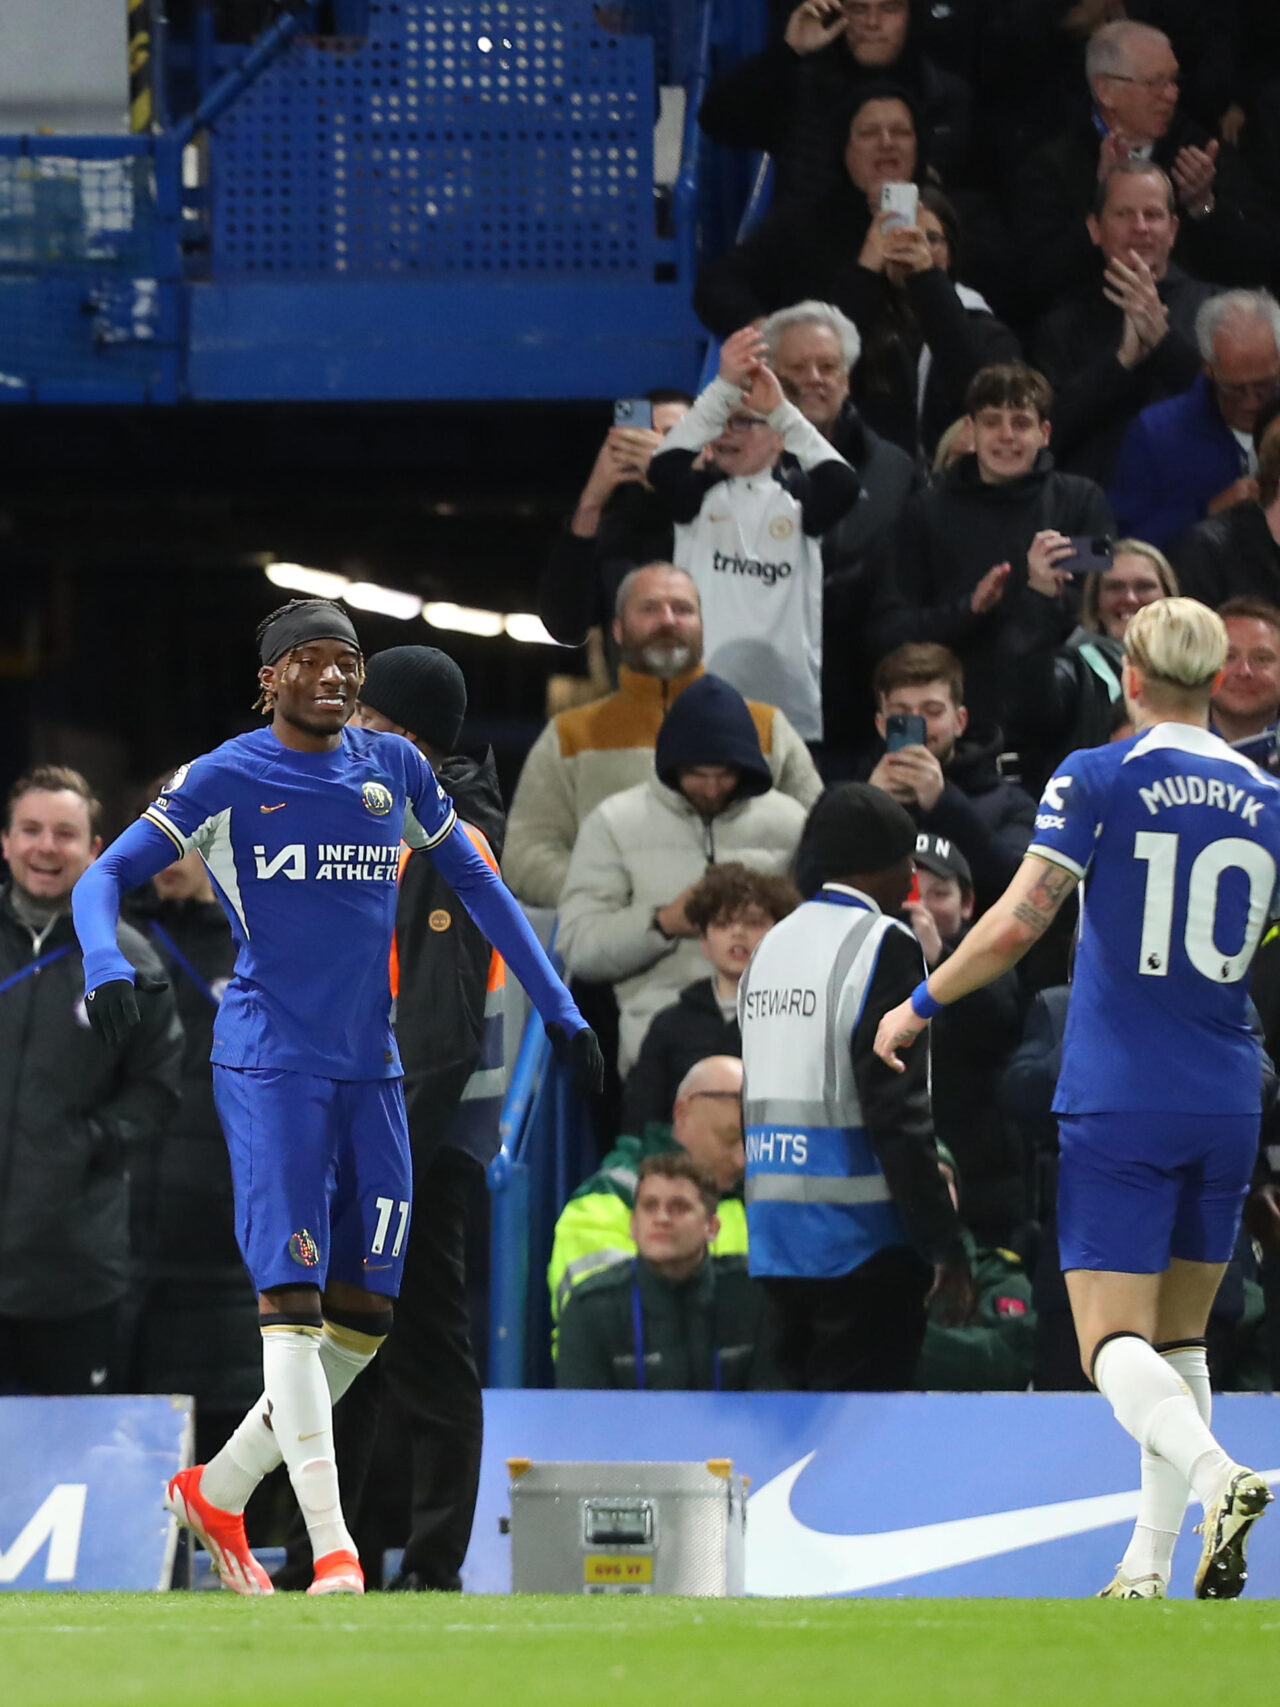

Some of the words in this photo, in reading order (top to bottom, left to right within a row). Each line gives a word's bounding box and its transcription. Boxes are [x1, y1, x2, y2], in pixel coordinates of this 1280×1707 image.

[713, 549, 792, 587] trivago
[1138, 775, 1265, 827] MUDRYK
[1133, 830, 1277, 984] 10
[746, 988, 817, 1020] STEWARD
[371, 1196, 410, 1258] 11
